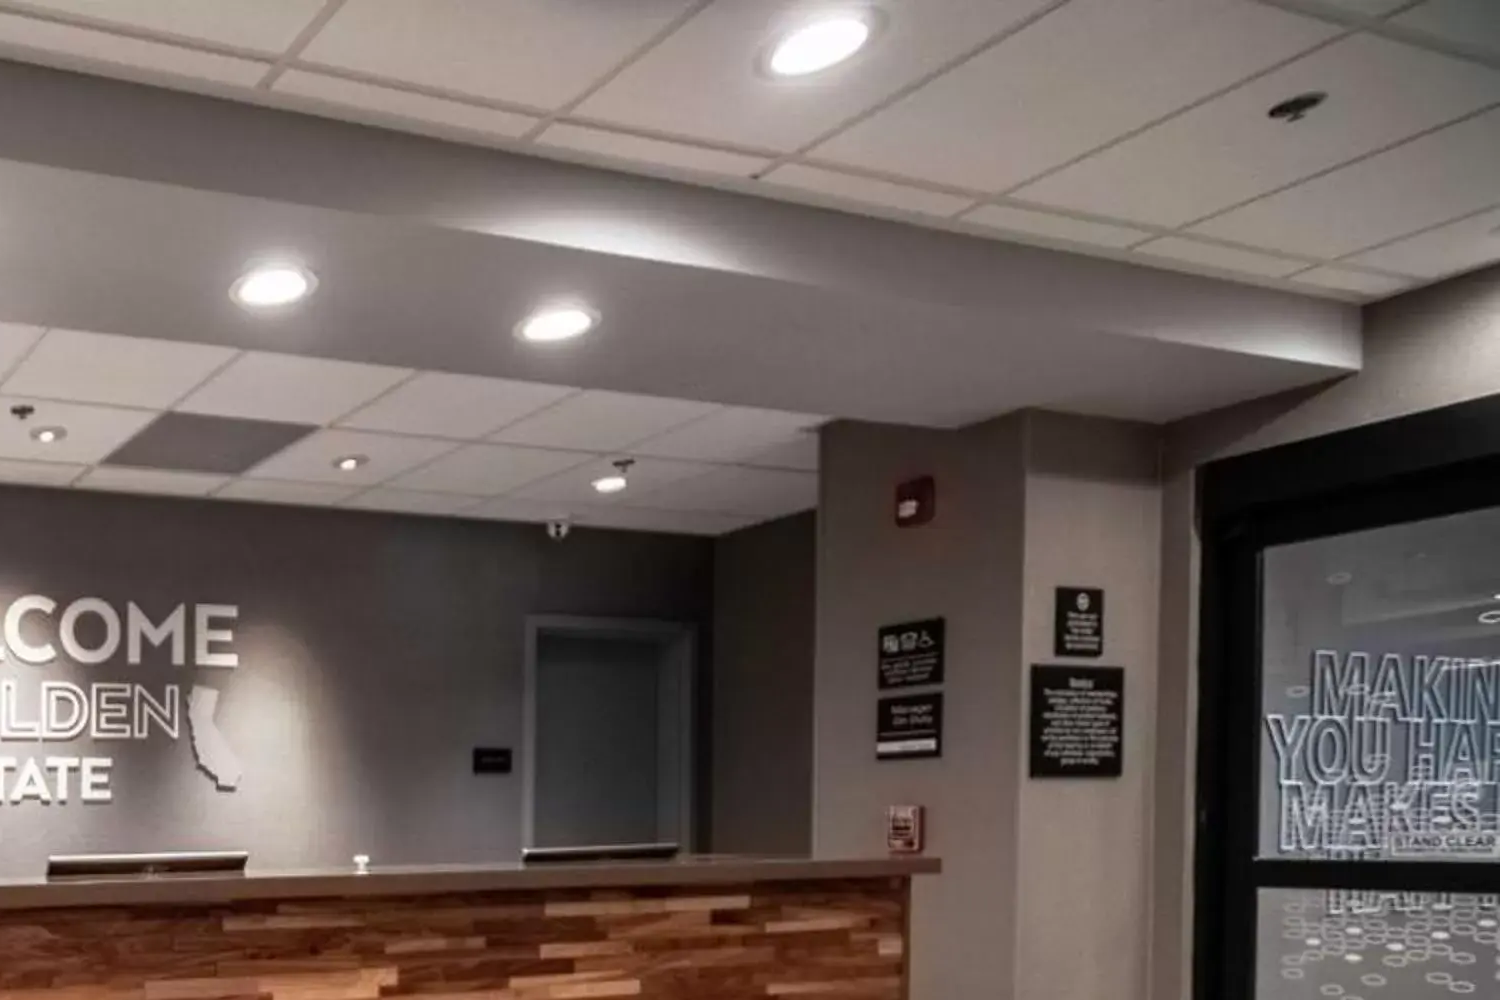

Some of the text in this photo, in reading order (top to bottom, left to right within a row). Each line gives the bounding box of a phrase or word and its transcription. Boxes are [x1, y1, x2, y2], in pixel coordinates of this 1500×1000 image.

[1266, 714, 1391, 785] YOU
[1280, 781, 1478, 850] MAKES
[1395, 834, 1496, 848] STAND CLEAR
